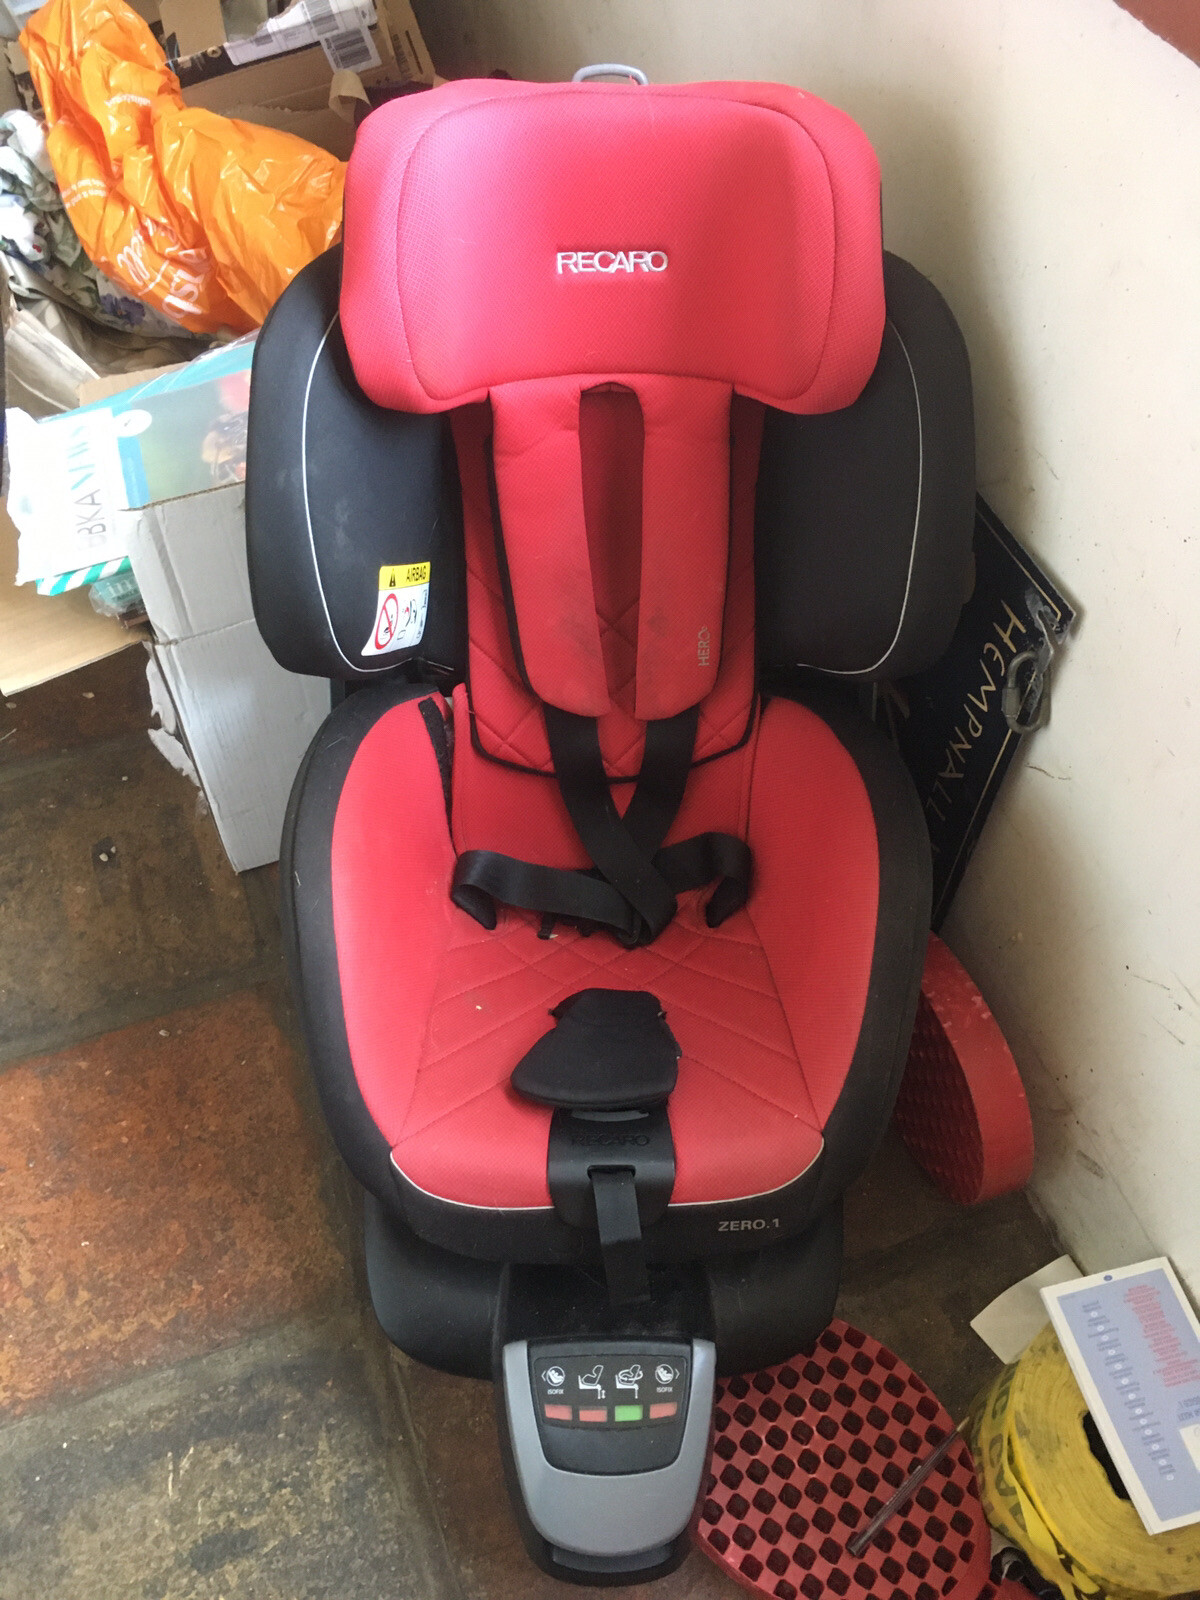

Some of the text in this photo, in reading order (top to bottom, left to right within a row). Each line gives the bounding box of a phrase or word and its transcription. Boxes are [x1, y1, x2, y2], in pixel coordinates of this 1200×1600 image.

[556, 250, 669, 274] RECARO
[406, 565, 427, 583] AIRBAG
[697, 625, 711, 666] HERO
[926, 599, 1028, 822] HEMPNALL
[571, 1133, 650, 1148] RECARO
[717, 1218, 780, 1233] ZERO.1
